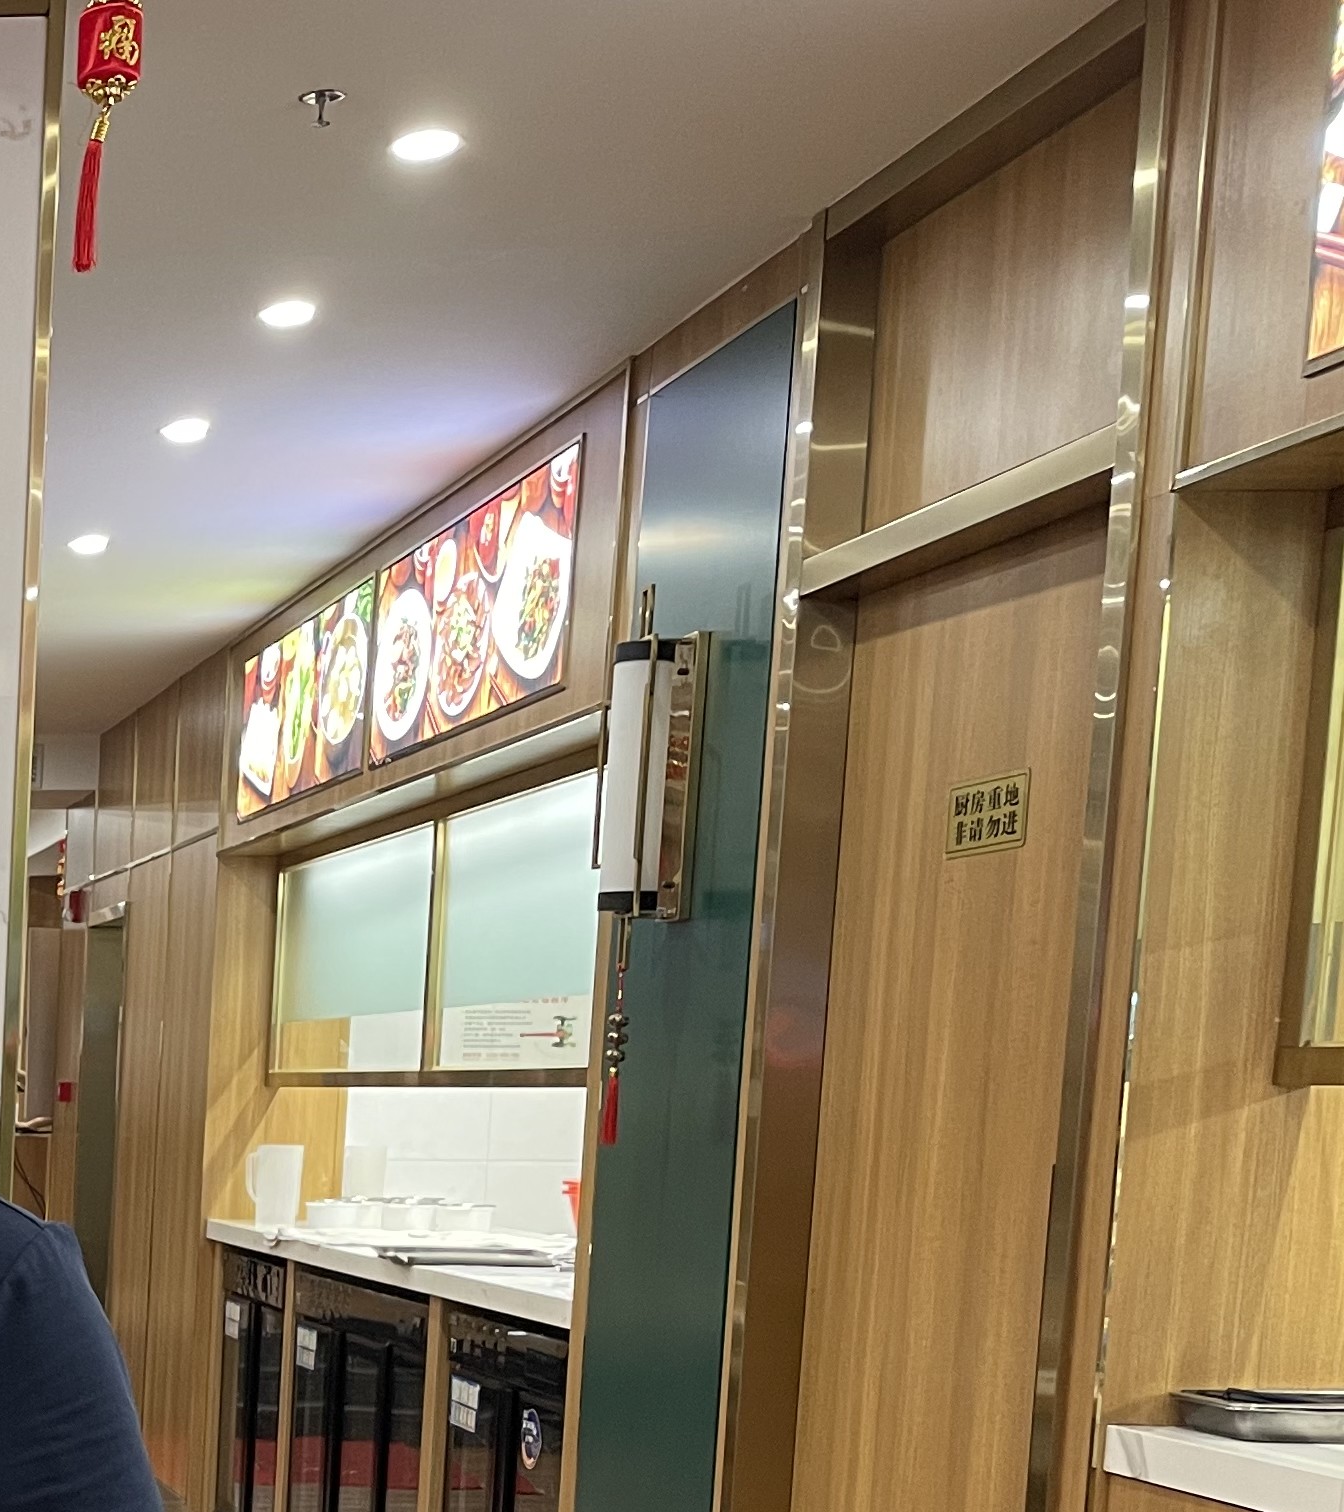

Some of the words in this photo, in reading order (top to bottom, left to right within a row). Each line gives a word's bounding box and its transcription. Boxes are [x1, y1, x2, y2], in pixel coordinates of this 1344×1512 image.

[953, 781, 1020, 818] 厨房重地
[955, 810, 1018, 846] 非请勿进
